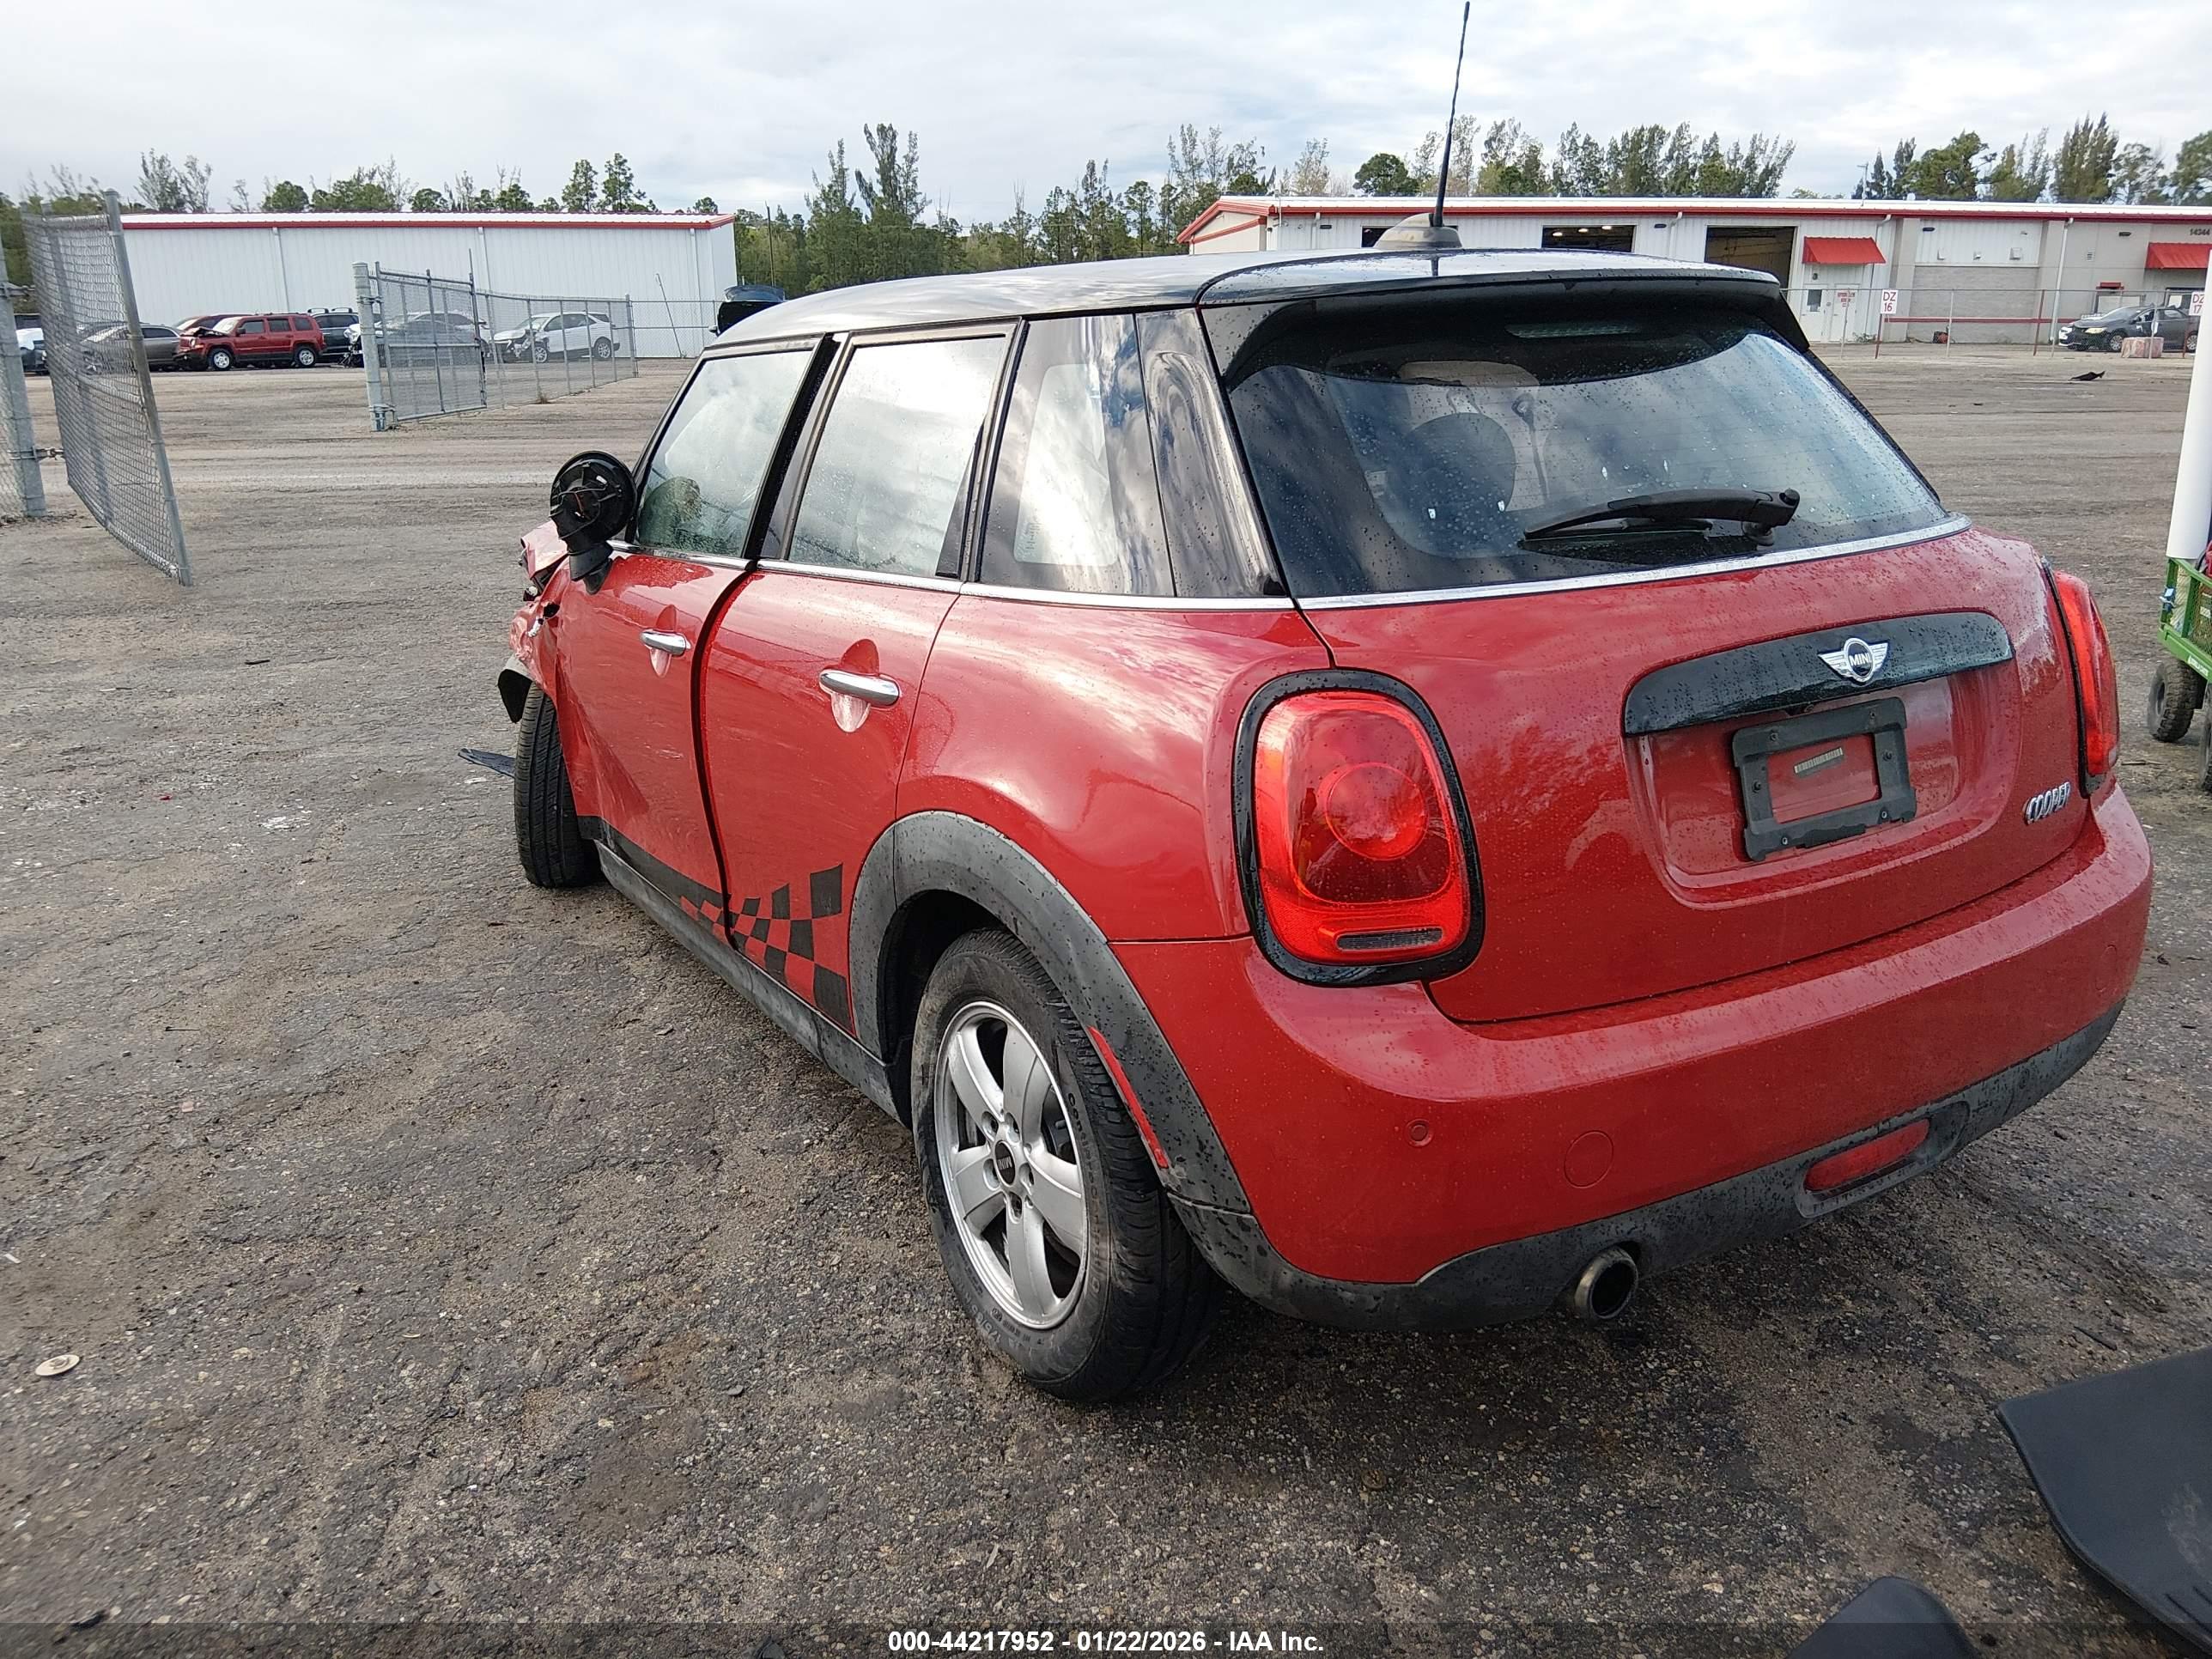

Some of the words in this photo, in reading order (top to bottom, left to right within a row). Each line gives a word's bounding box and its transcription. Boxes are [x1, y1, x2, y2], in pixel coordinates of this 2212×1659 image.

[1882, 291, 1897, 302] DZ
[1884, 302, 1893, 312] 16
[2193, 304, 2202, 313] 17
[1848, 652, 1872, 666] MINI
[2026, 781, 2070, 824] COOPER
